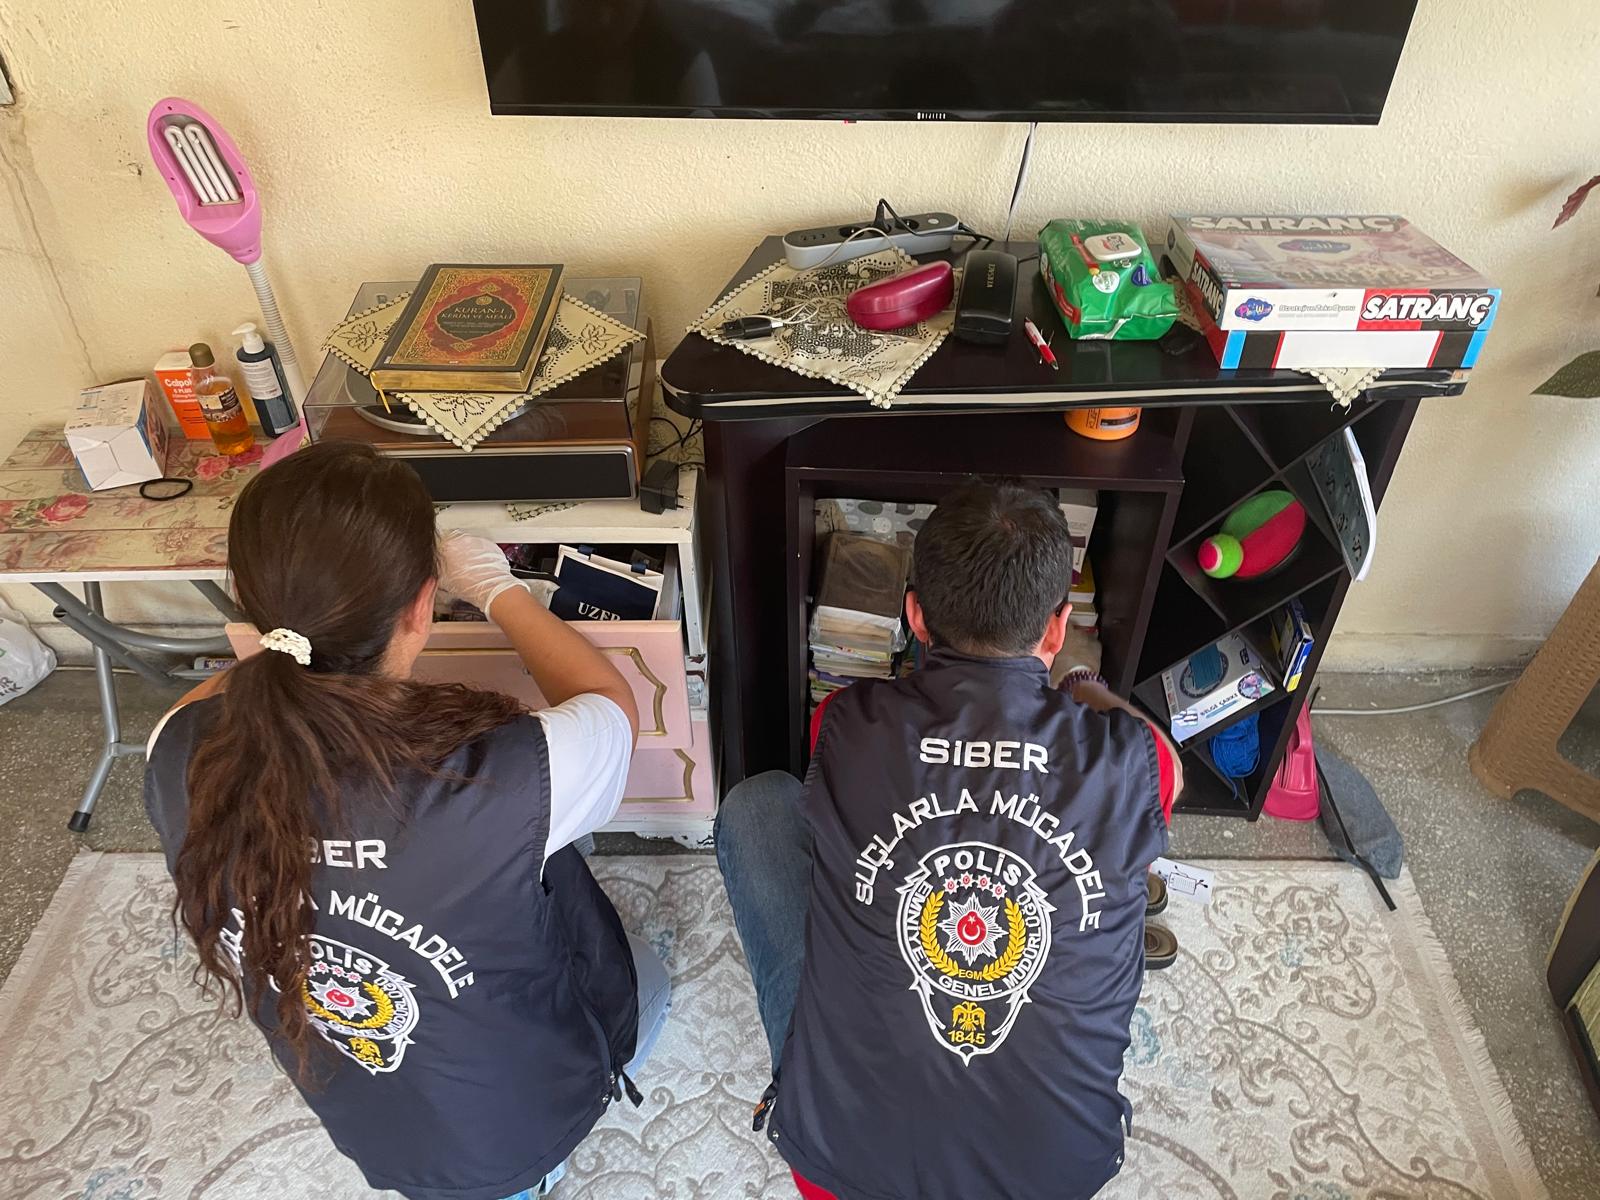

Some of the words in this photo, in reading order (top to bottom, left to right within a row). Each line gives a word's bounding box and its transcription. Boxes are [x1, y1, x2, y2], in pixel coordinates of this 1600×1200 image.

[1361, 295, 1493, 326] SATRANÇ
[855, 788, 979, 905] SUÇLARLA
[988, 789, 1106, 932] MÜCADELE
[328, 889, 475, 999] MÜCADELE
[939, 975, 1003, 997] GENEL
[958, 969, 983, 981] EGM
[948, 1030, 986, 1045] 1845
